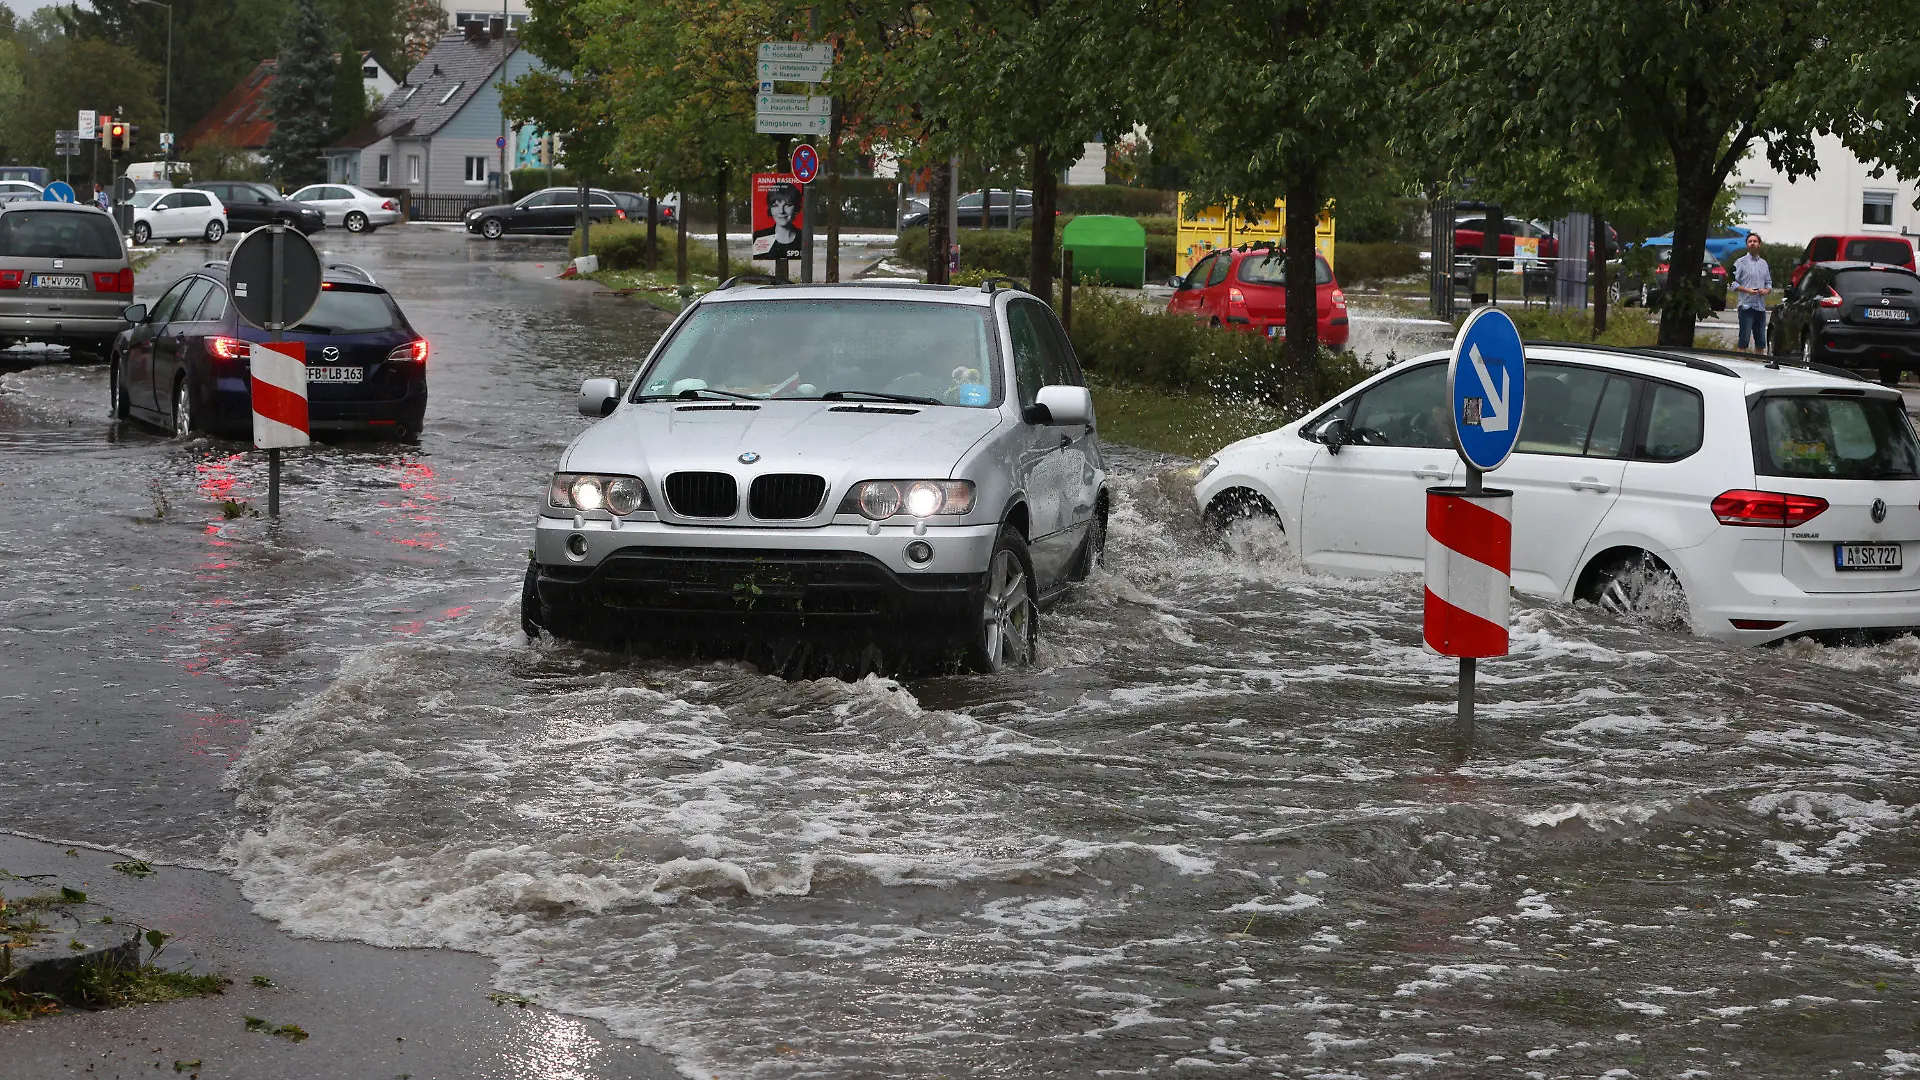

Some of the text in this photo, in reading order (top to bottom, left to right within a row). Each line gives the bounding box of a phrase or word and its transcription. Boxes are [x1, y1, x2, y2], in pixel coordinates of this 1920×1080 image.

[760, 120, 802, 128] Königsbrunn
[41, 277, 46, 285] A
[64, 277, 80, 286] 992
[306, 368, 362, 380] FB LB 163
[1847, 547, 1897, 565] A SR 727
